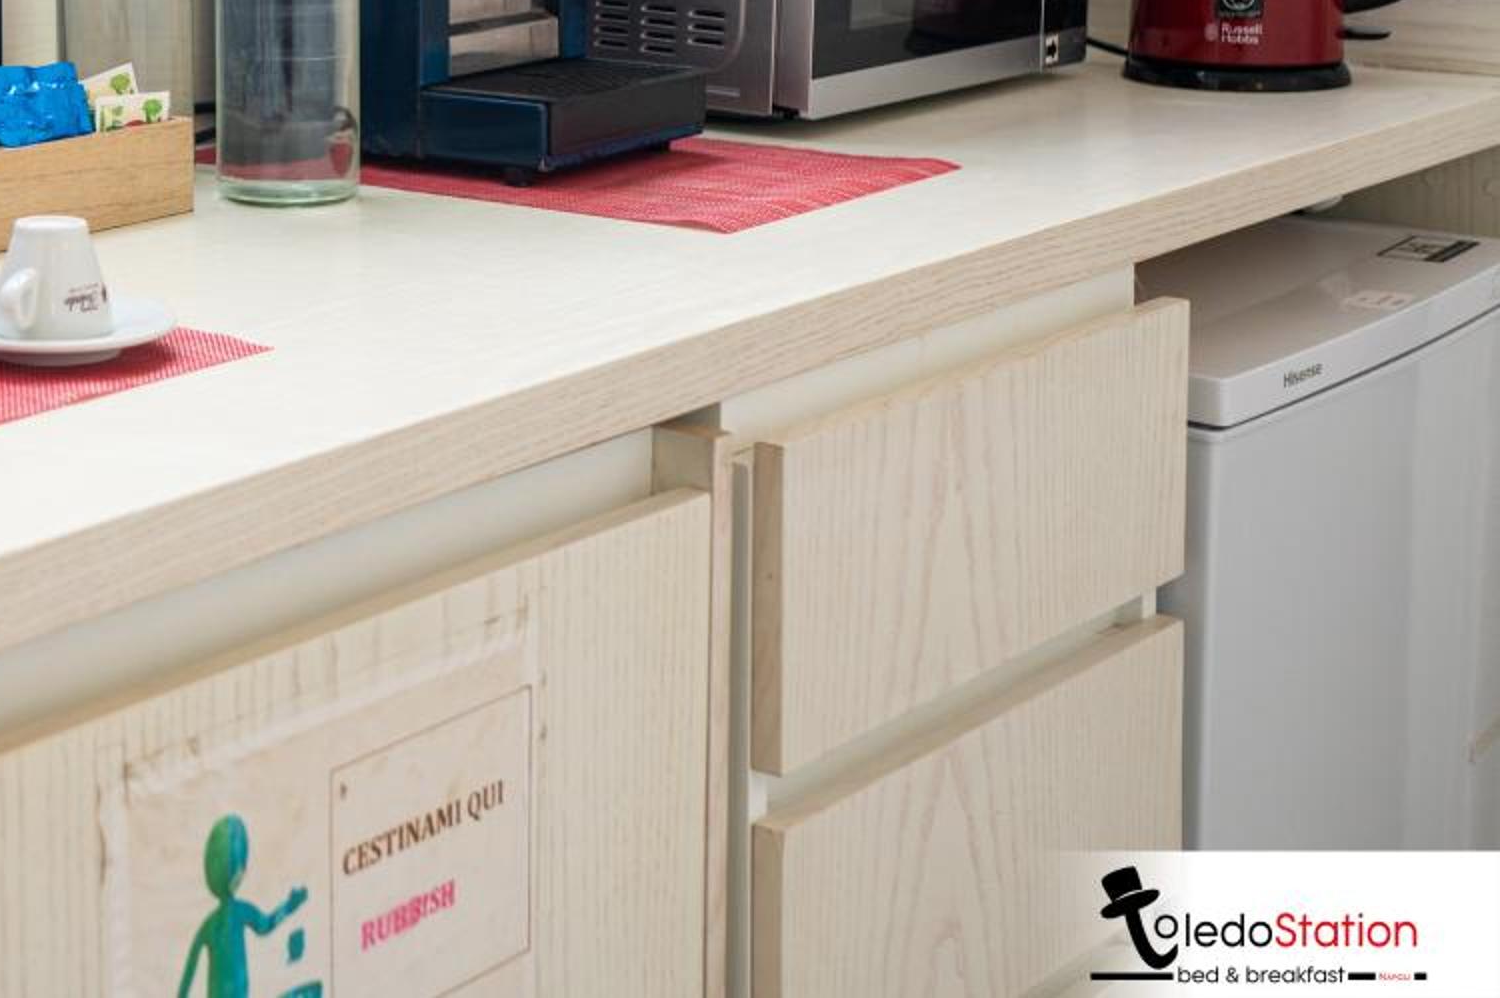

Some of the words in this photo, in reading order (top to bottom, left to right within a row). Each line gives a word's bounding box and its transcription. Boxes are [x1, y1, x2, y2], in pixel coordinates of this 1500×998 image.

[343, 799, 462, 875] CESTINAMI
[467, 779, 504, 821] QUI
[360, 878, 456, 951] RUBBISH
